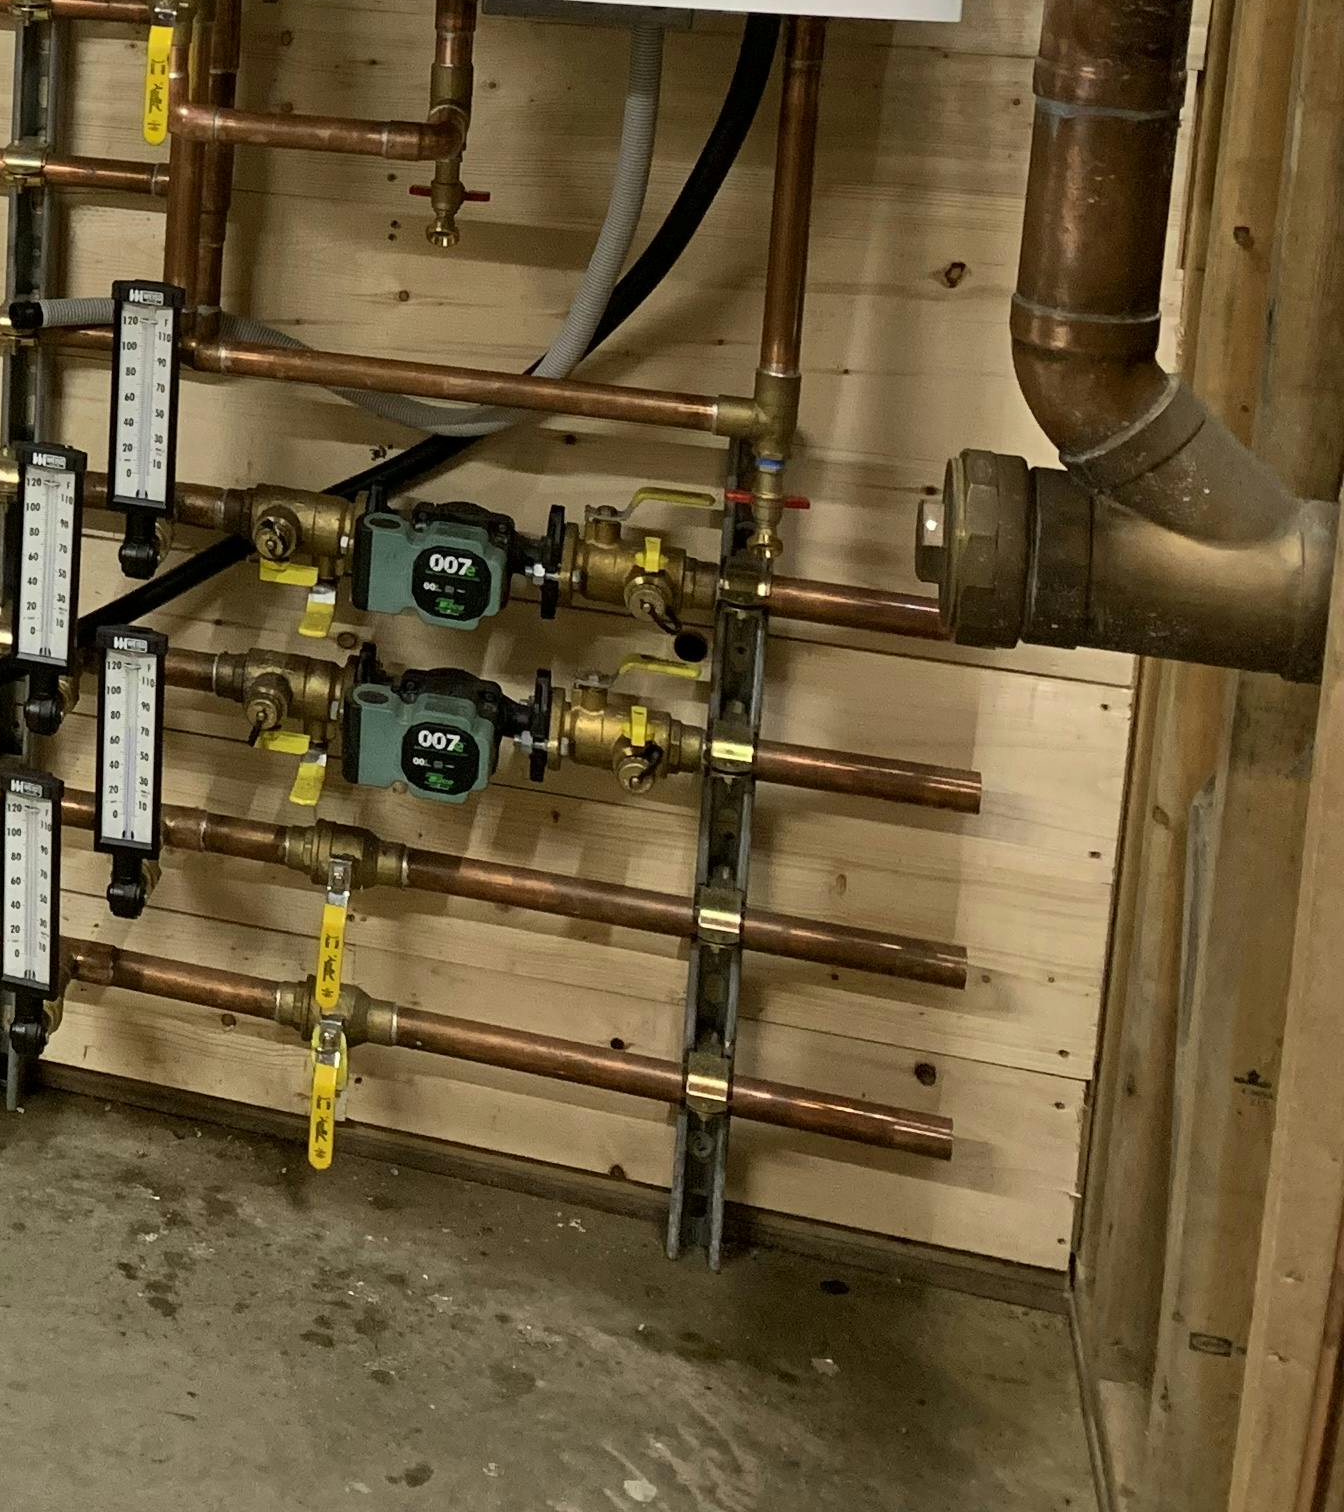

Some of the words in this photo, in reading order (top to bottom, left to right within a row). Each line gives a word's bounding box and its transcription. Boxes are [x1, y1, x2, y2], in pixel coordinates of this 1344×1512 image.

[123, 316, 138, 325] 120
[158, 332, 172, 342] 110
[121, 342, 137, 351] 100
[157, 359, 166, 368] 90
[125, 367, 136, 376] 80
[156, 384, 165, 393] 70
[124, 393, 135, 401] 60
[155, 409, 164, 419] 50
[123, 418, 134, 426] 40
[154, 434, 163, 444] 30
[122, 443, 133, 452] 20
[153, 459, 162, 469] 10
[126, 469, 132, 477] 0
[26, 478, 41, 486] 120
[61, 493, 74, 505] 110
[26, 503, 40, 511] 100
[60, 519, 69, 528] 90
[29, 528, 39, 536] 80
[59, 544, 68, 553] 70
[28, 552, 38, 561] 60
[58, 569, 67, 579] 50
[27, 577, 38, 586] 40
[57, 593, 66, 603] 30
[26, 602, 37, 610] 20
[56, 618, 64, 628] 10
[30, 626, 35, 635] 0
[107, 661, 122, 670] 120
[142, 677, 154, 688] 110
[106, 686, 121, 695] 100
[141, 702, 150, 712] 90
[110, 711, 121, 720] 80
[140, 727, 149, 736] 70
[109, 736, 120, 744] 60
[140, 752, 149, 761] 50
[109, 761, 119, 769] 40
[139, 777, 148, 786] 30
[108, 785, 118, 794] 20
[7, 804, 22, 812] 120
[138, 801, 147, 811] 10
[112, 810, 118, 818] 0
[40, 821, 52, 832] 110
[7, 828, 22, 836] 100
[40, 845, 48, 855] 90
[10, 852, 21, 861] 80
[40, 869, 48, 879] 70
[10, 877, 21, 885] 60
[39, 895, 48, 904] 50
[10, 901, 21, 910] 40
[39, 918, 47, 928] 30
[10, 925, 20, 934] 20
[39, 942, 46, 952] 10
[14, 949, 20, 957] 0
